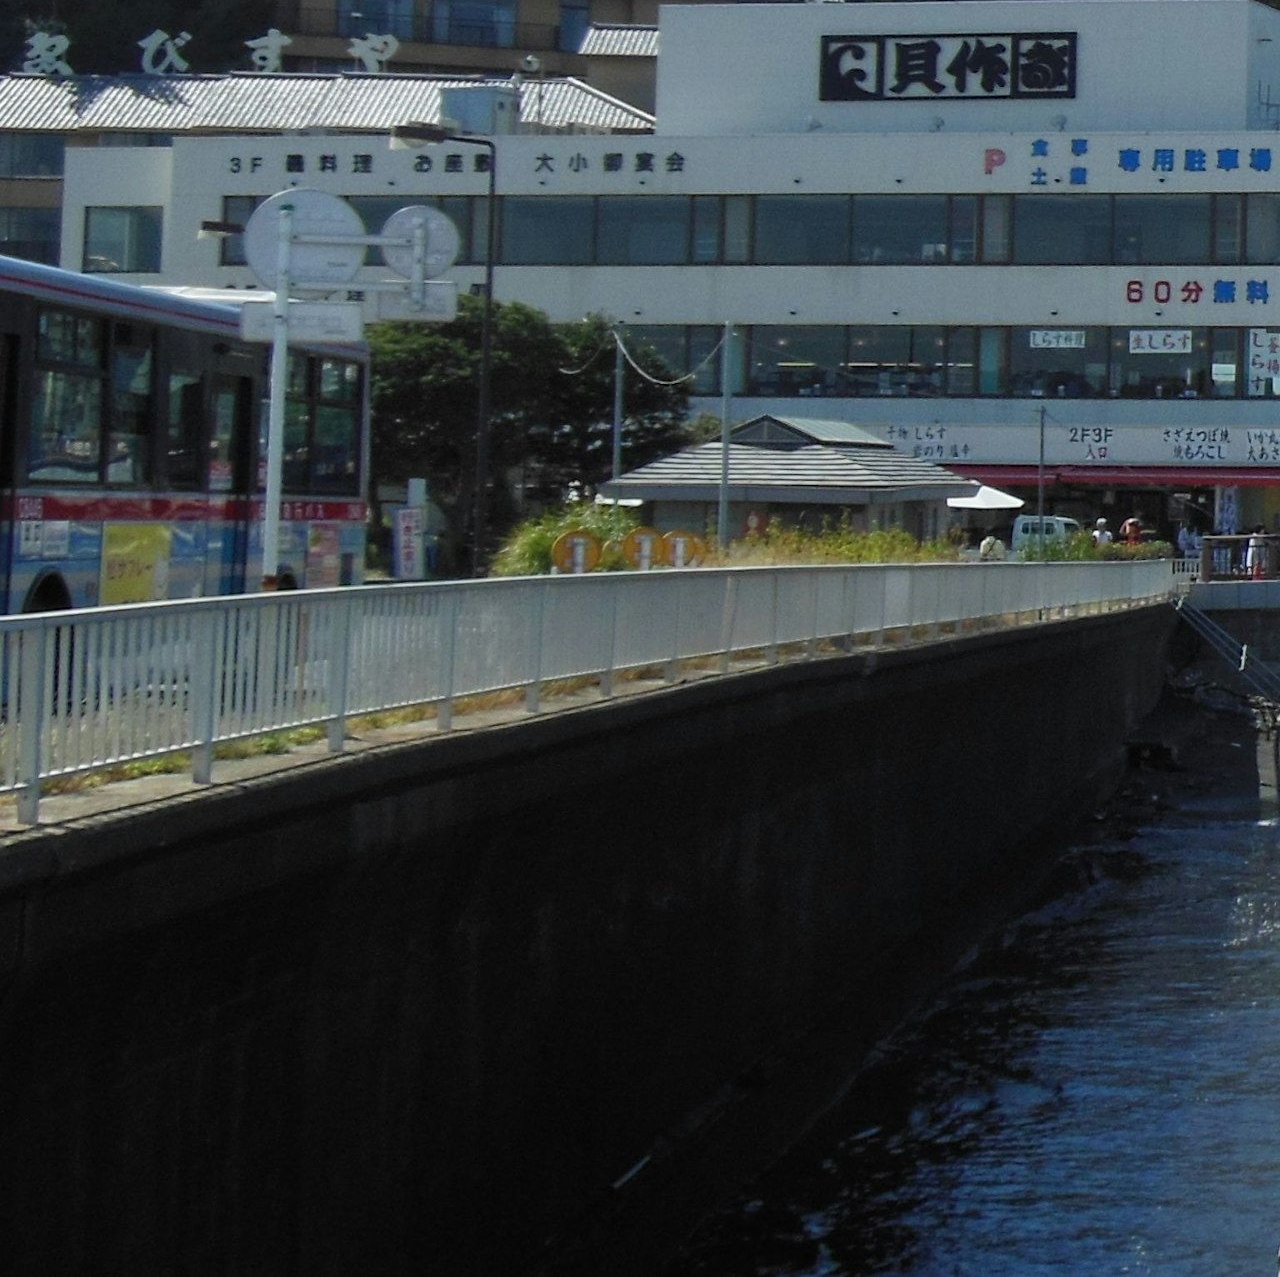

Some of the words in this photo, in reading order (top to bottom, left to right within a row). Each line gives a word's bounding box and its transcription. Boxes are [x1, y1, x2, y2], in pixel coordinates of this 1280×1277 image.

[889, 38, 1010, 94] 貝作
[230, 157, 262, 173] 3F
[985, 148, 1006, 174] P
[1118, 148, 1271, 171] 専用駐車場
[1127, 280, 1269, 304] 60分無料
[1132, 334, 1190, 350] 生しらす
[1252, 332, 1264, 391] しらす
[915, 427, 946, 439] しらす
[1070, 427, 1114, 443] 2F3F
[1163, 427, 1230, 443] さざえつぼ焼
